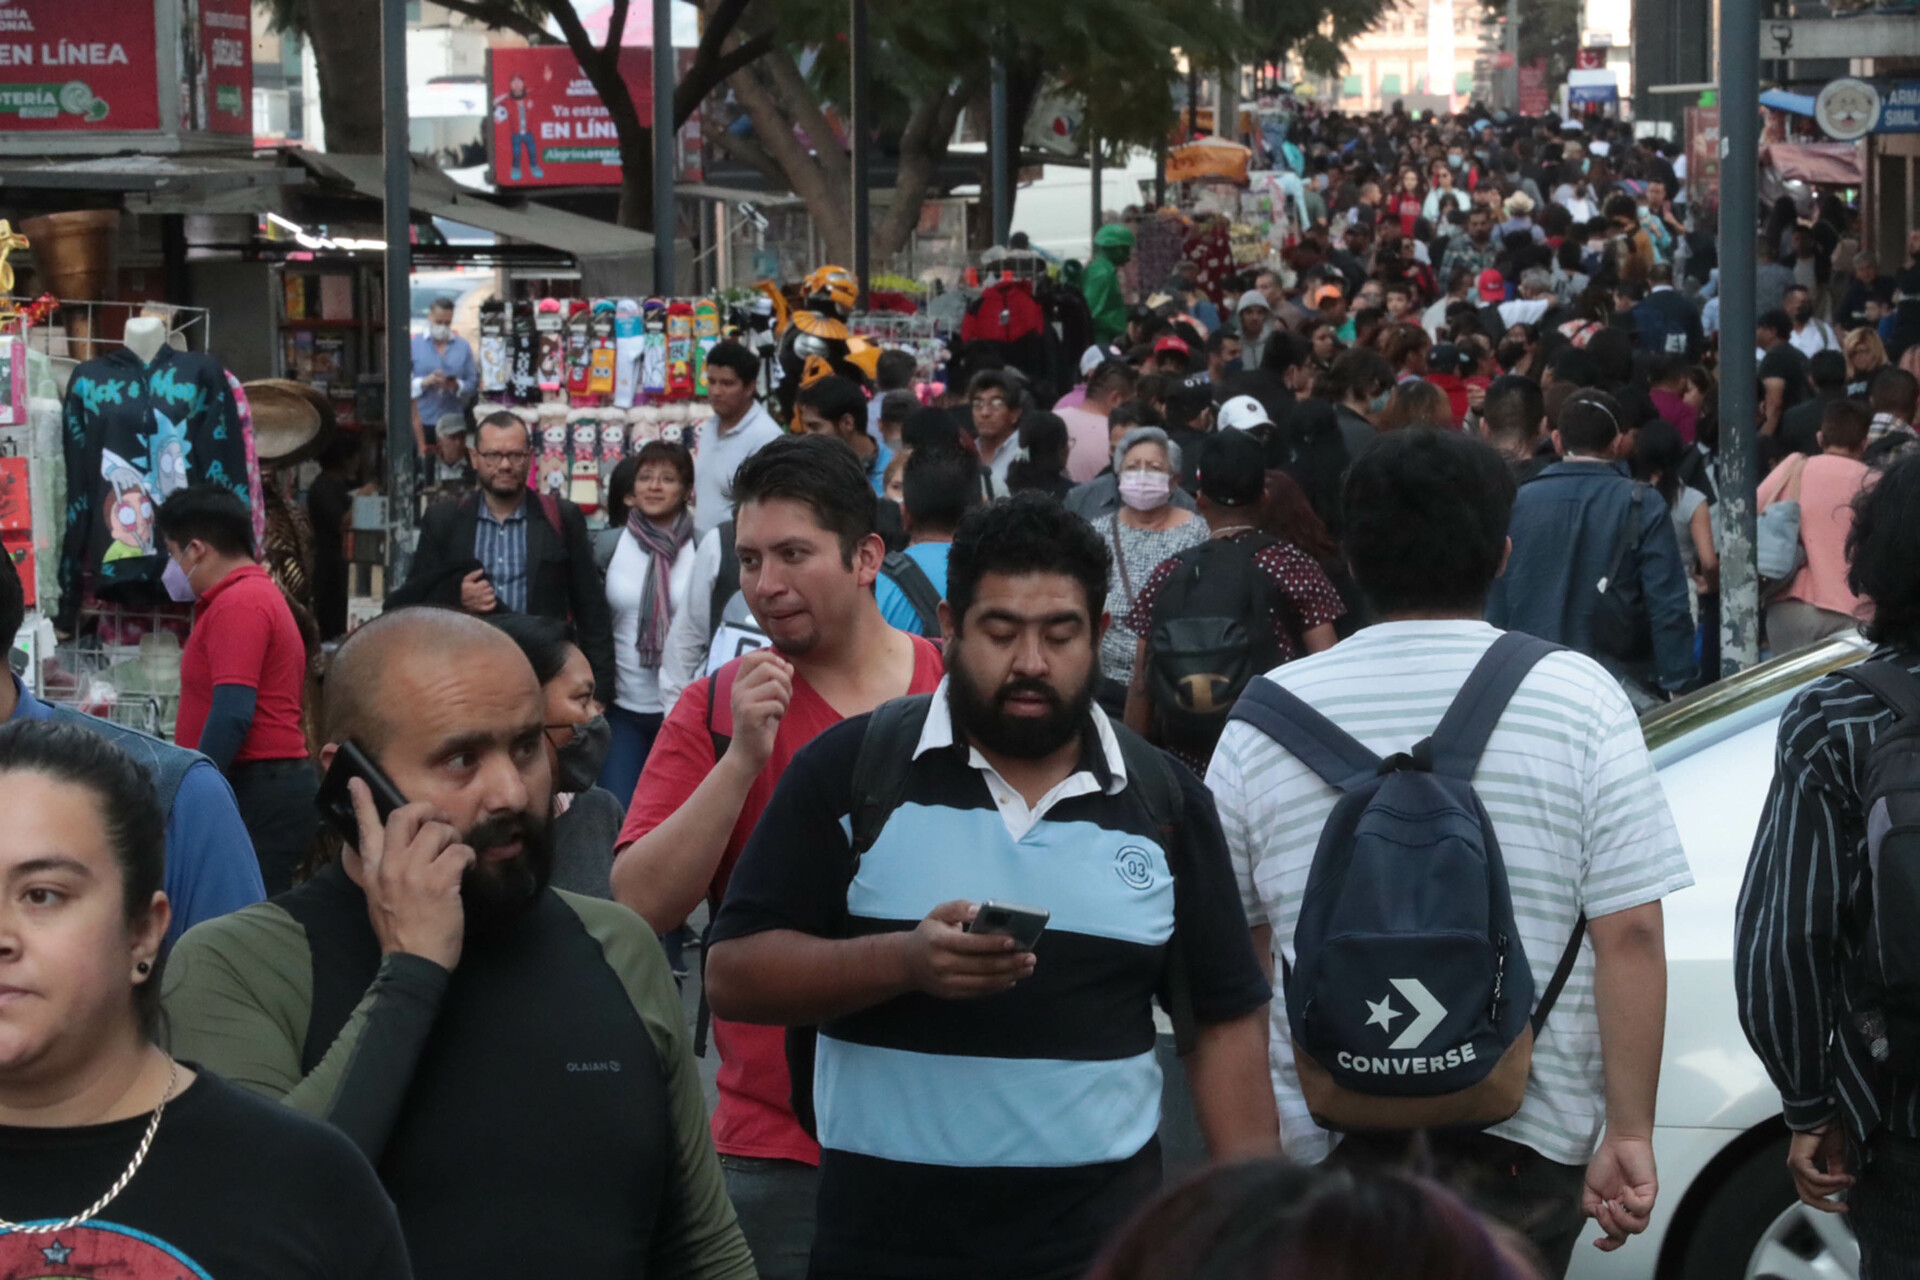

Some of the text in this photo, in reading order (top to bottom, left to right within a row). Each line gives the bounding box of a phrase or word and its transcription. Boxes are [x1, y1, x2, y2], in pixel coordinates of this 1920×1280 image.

[0, 38, 128, 65] EN LÍNEA
[0, 87, 57, 105] TERÍA
[541, 117, 619, 139] EN LÍN
[1127, 860, 1146, 878] 03
[1337, 1041, 1477, 1075] CONVERSE
